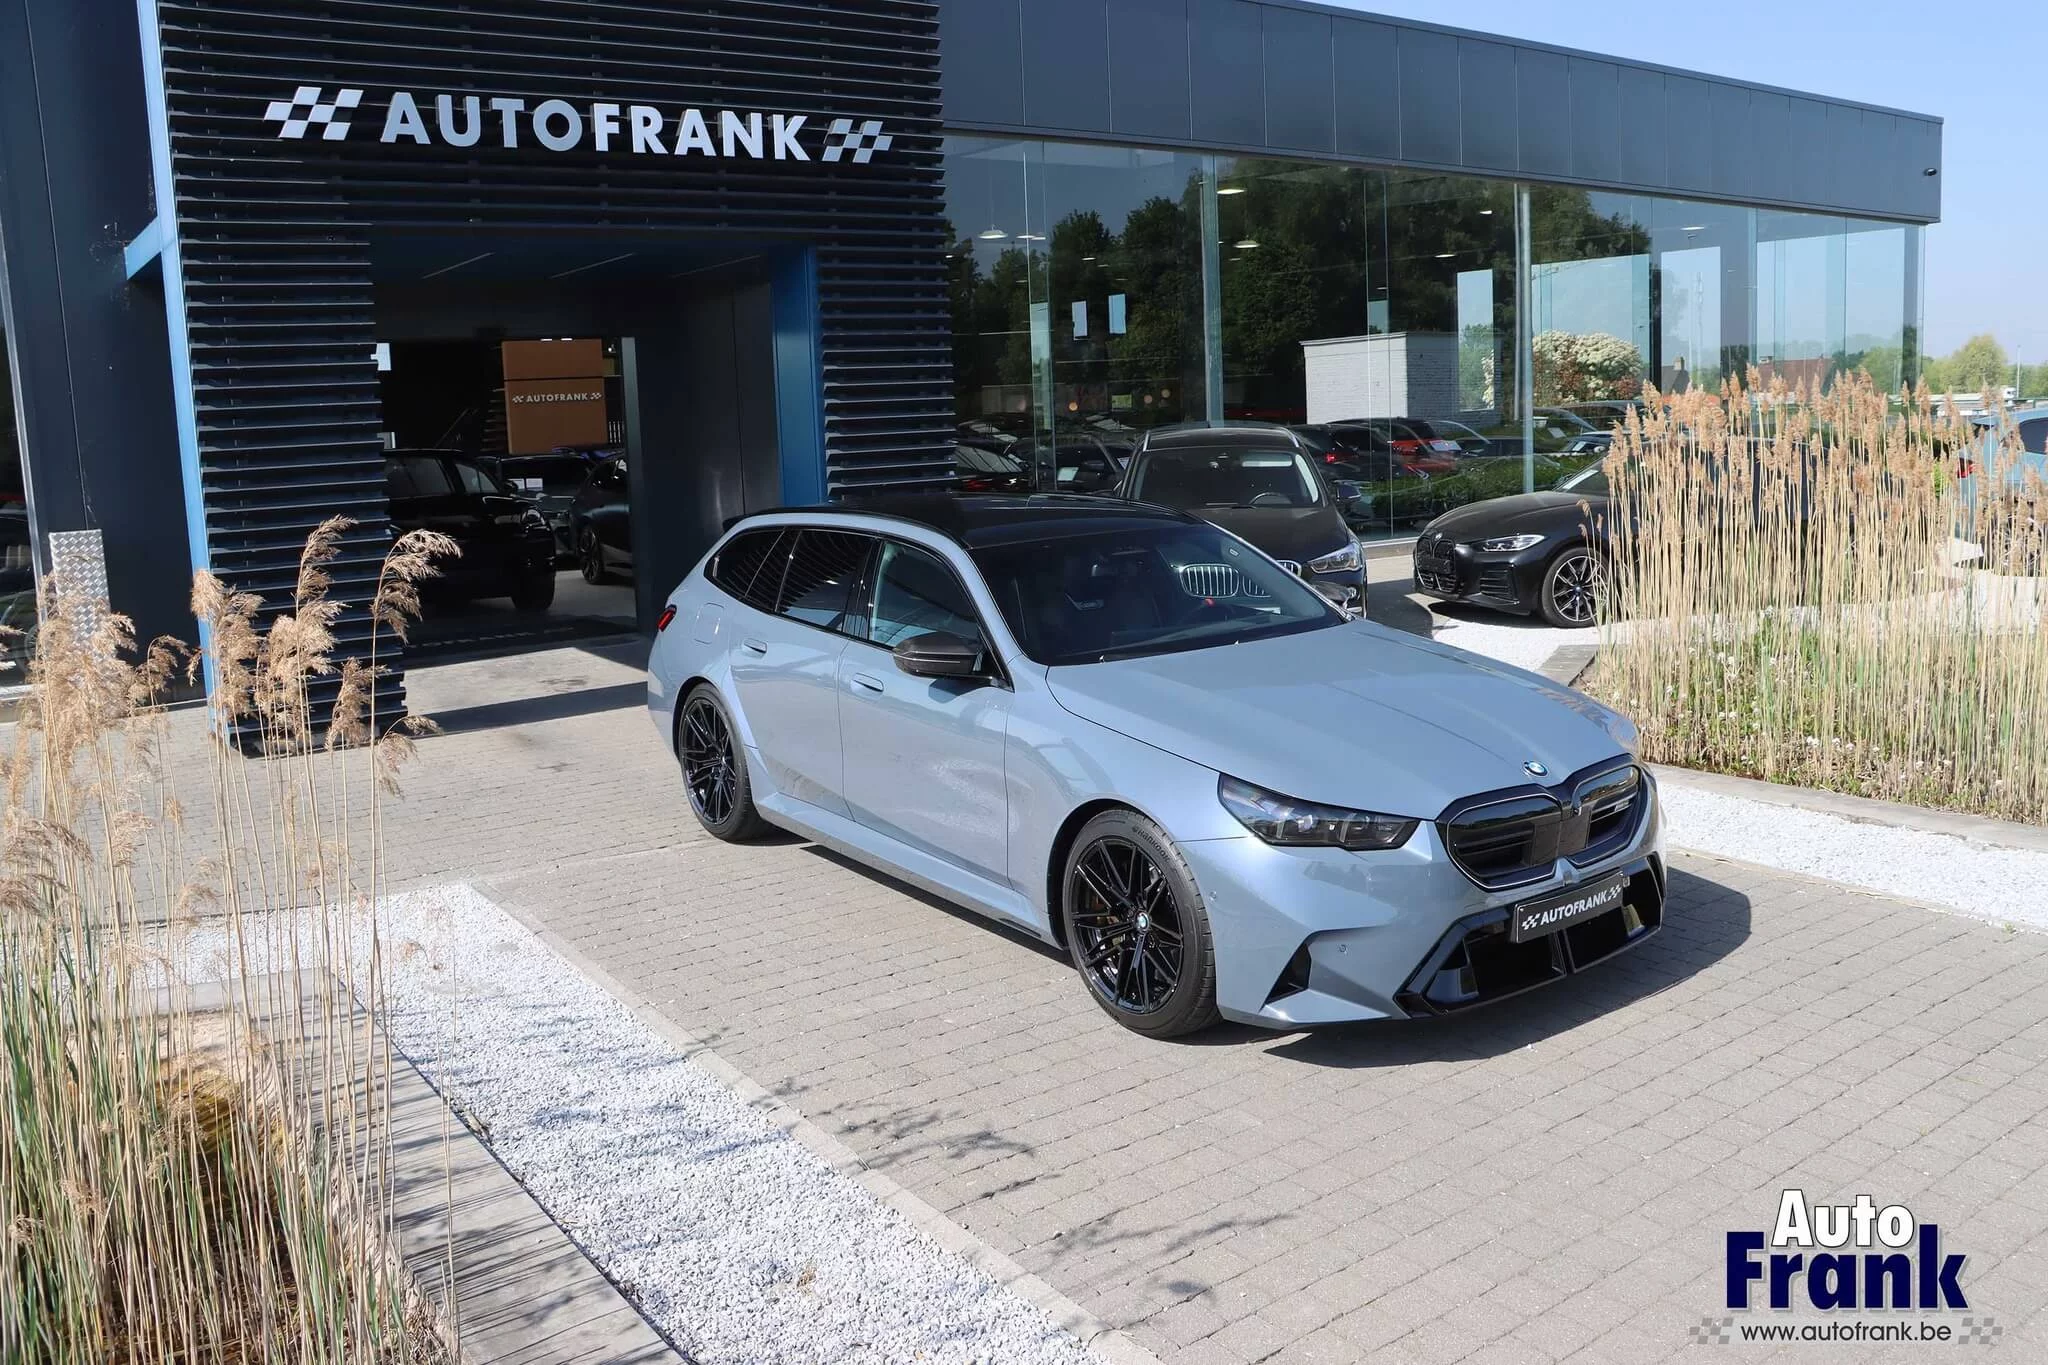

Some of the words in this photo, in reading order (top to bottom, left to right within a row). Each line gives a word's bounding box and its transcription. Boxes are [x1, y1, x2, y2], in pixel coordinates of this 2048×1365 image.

[380, 91, 811, 161] AUTOFRANK
[526, 392, 588, 403] AUTOFRANK
[1540, 890, 1607, 925] AUTOFRANK
